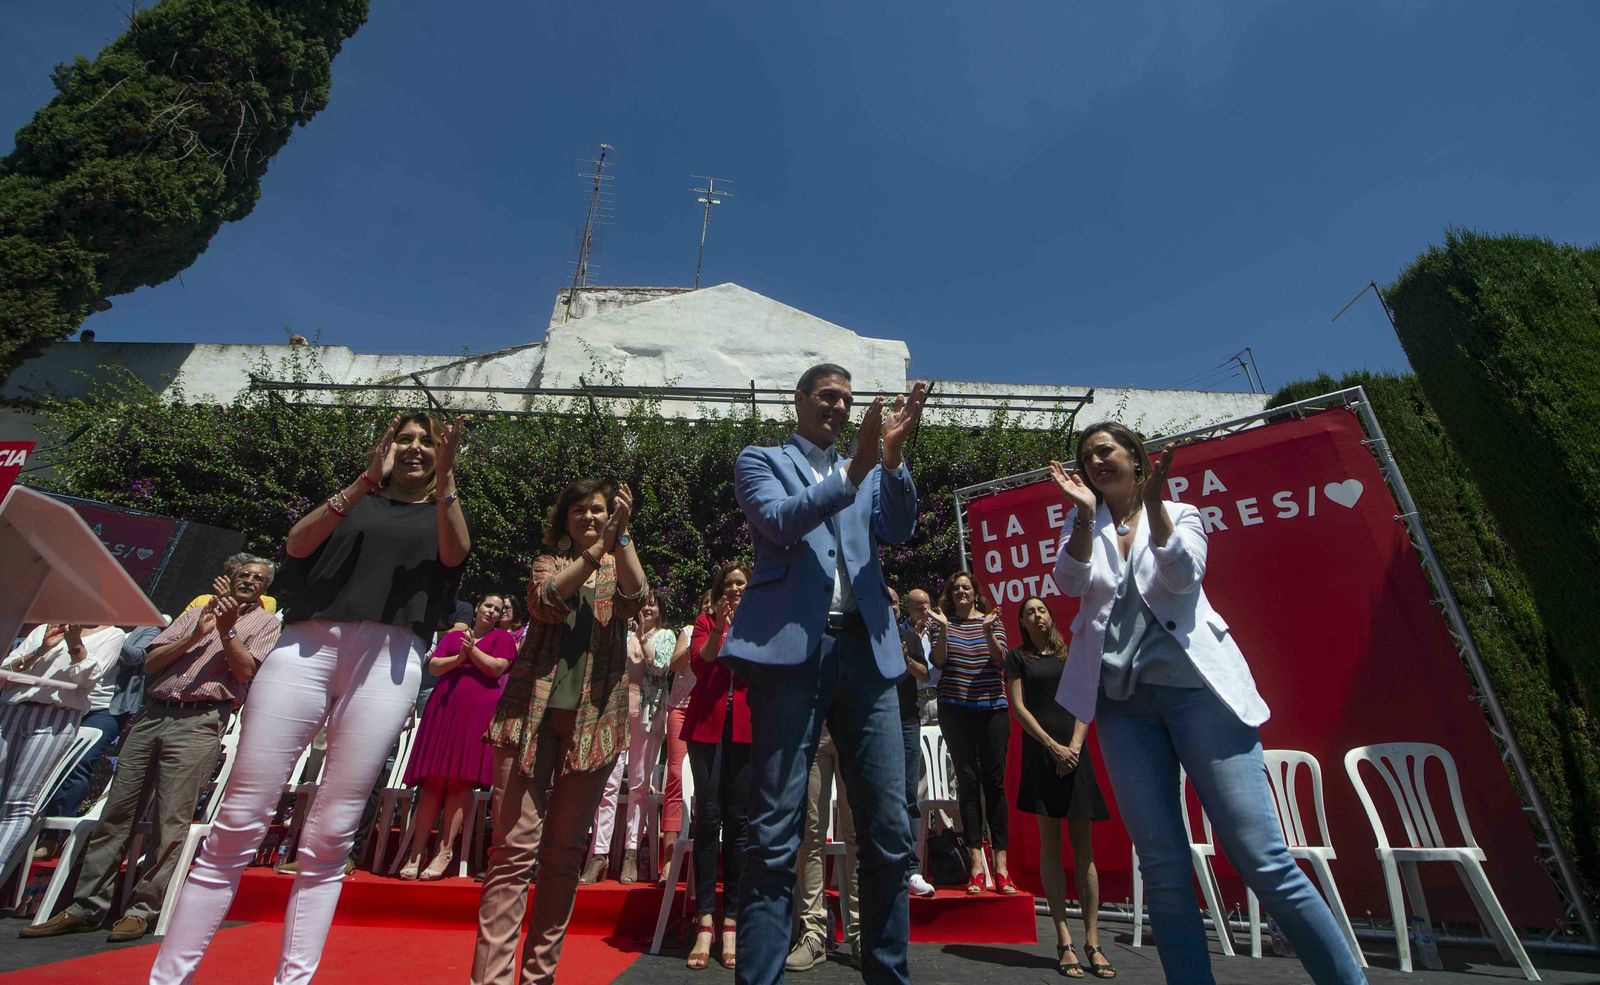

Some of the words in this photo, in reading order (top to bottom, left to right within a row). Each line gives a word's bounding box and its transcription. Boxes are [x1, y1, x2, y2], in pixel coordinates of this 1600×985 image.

[981, 514, 1025, 543] LA
[984, 538, 1058, 574] QUE
[988, 573, 1061, 606] VOTA
